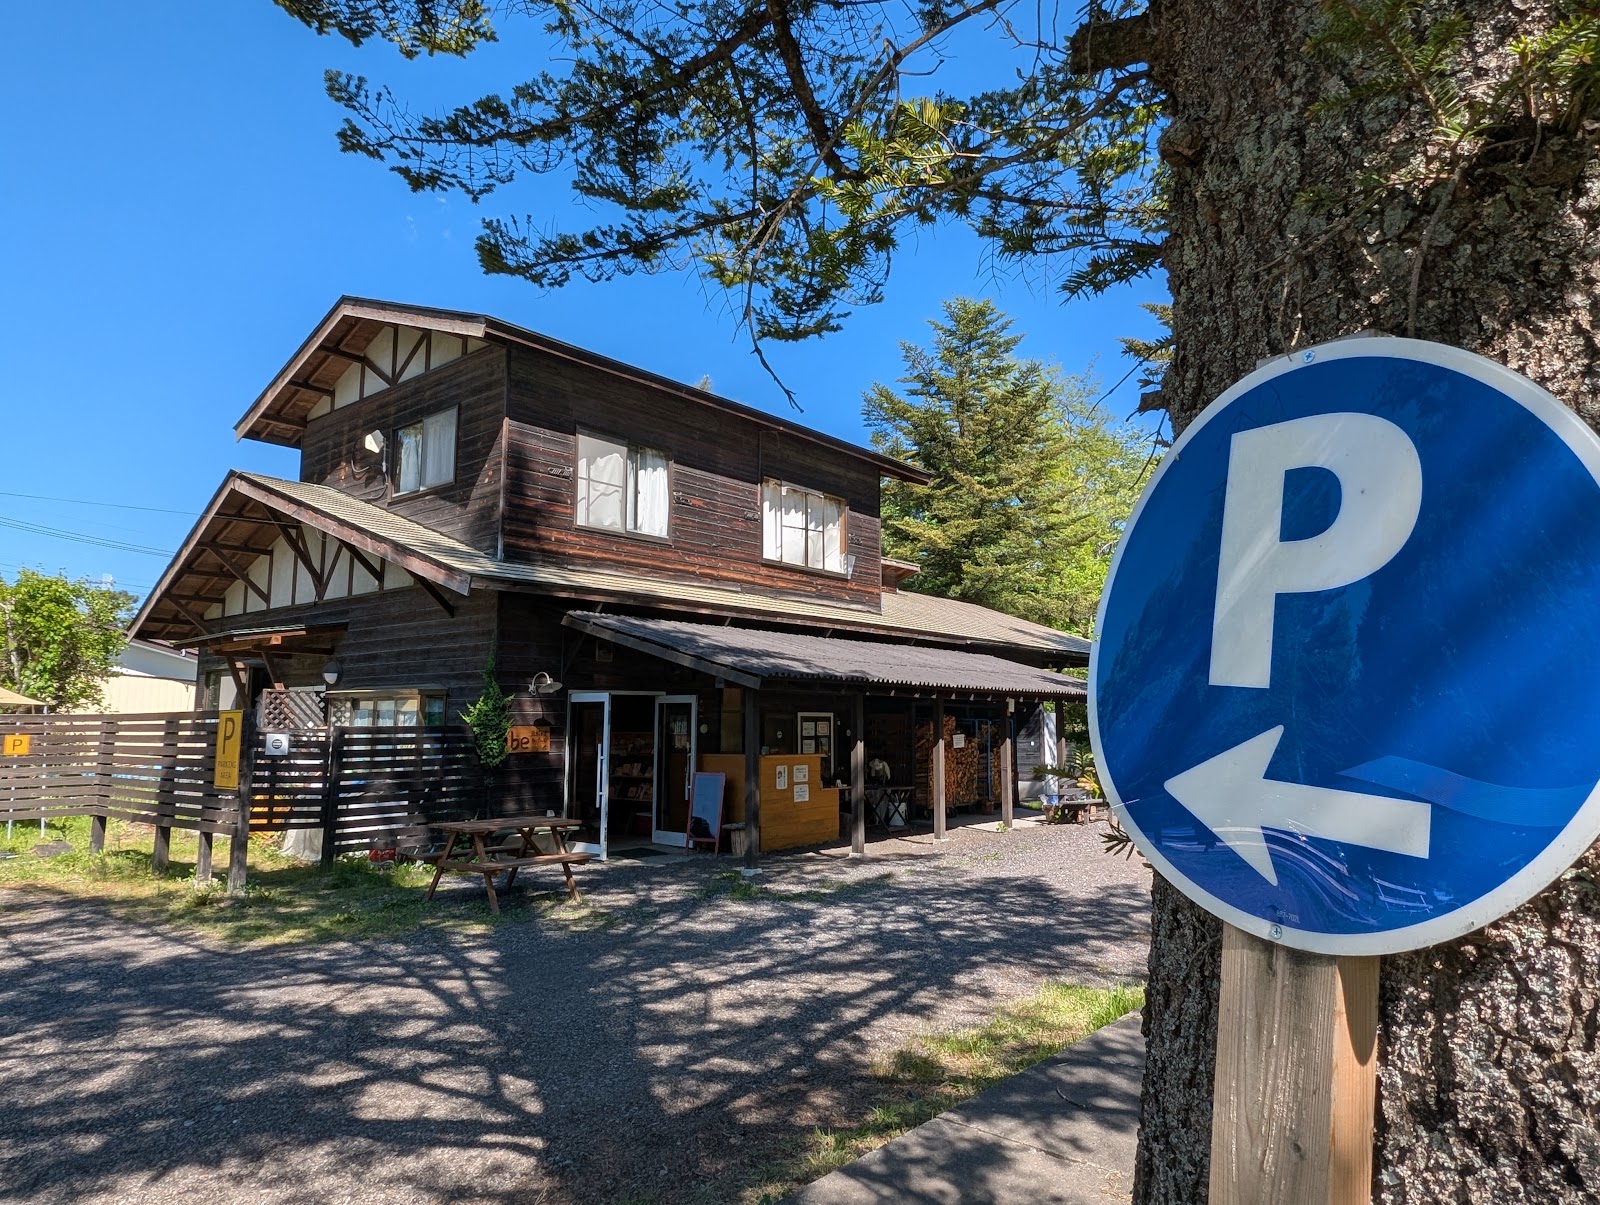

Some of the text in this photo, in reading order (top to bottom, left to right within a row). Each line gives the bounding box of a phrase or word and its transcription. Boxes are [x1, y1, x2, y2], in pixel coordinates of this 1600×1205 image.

[1209, 412, 1422, 689] P
[222, 717, 235, 755] P
[12, 738, 23, 751] P
[217, 760, 237, 769] PARKING
[220, 771, 232, 779] AREA
